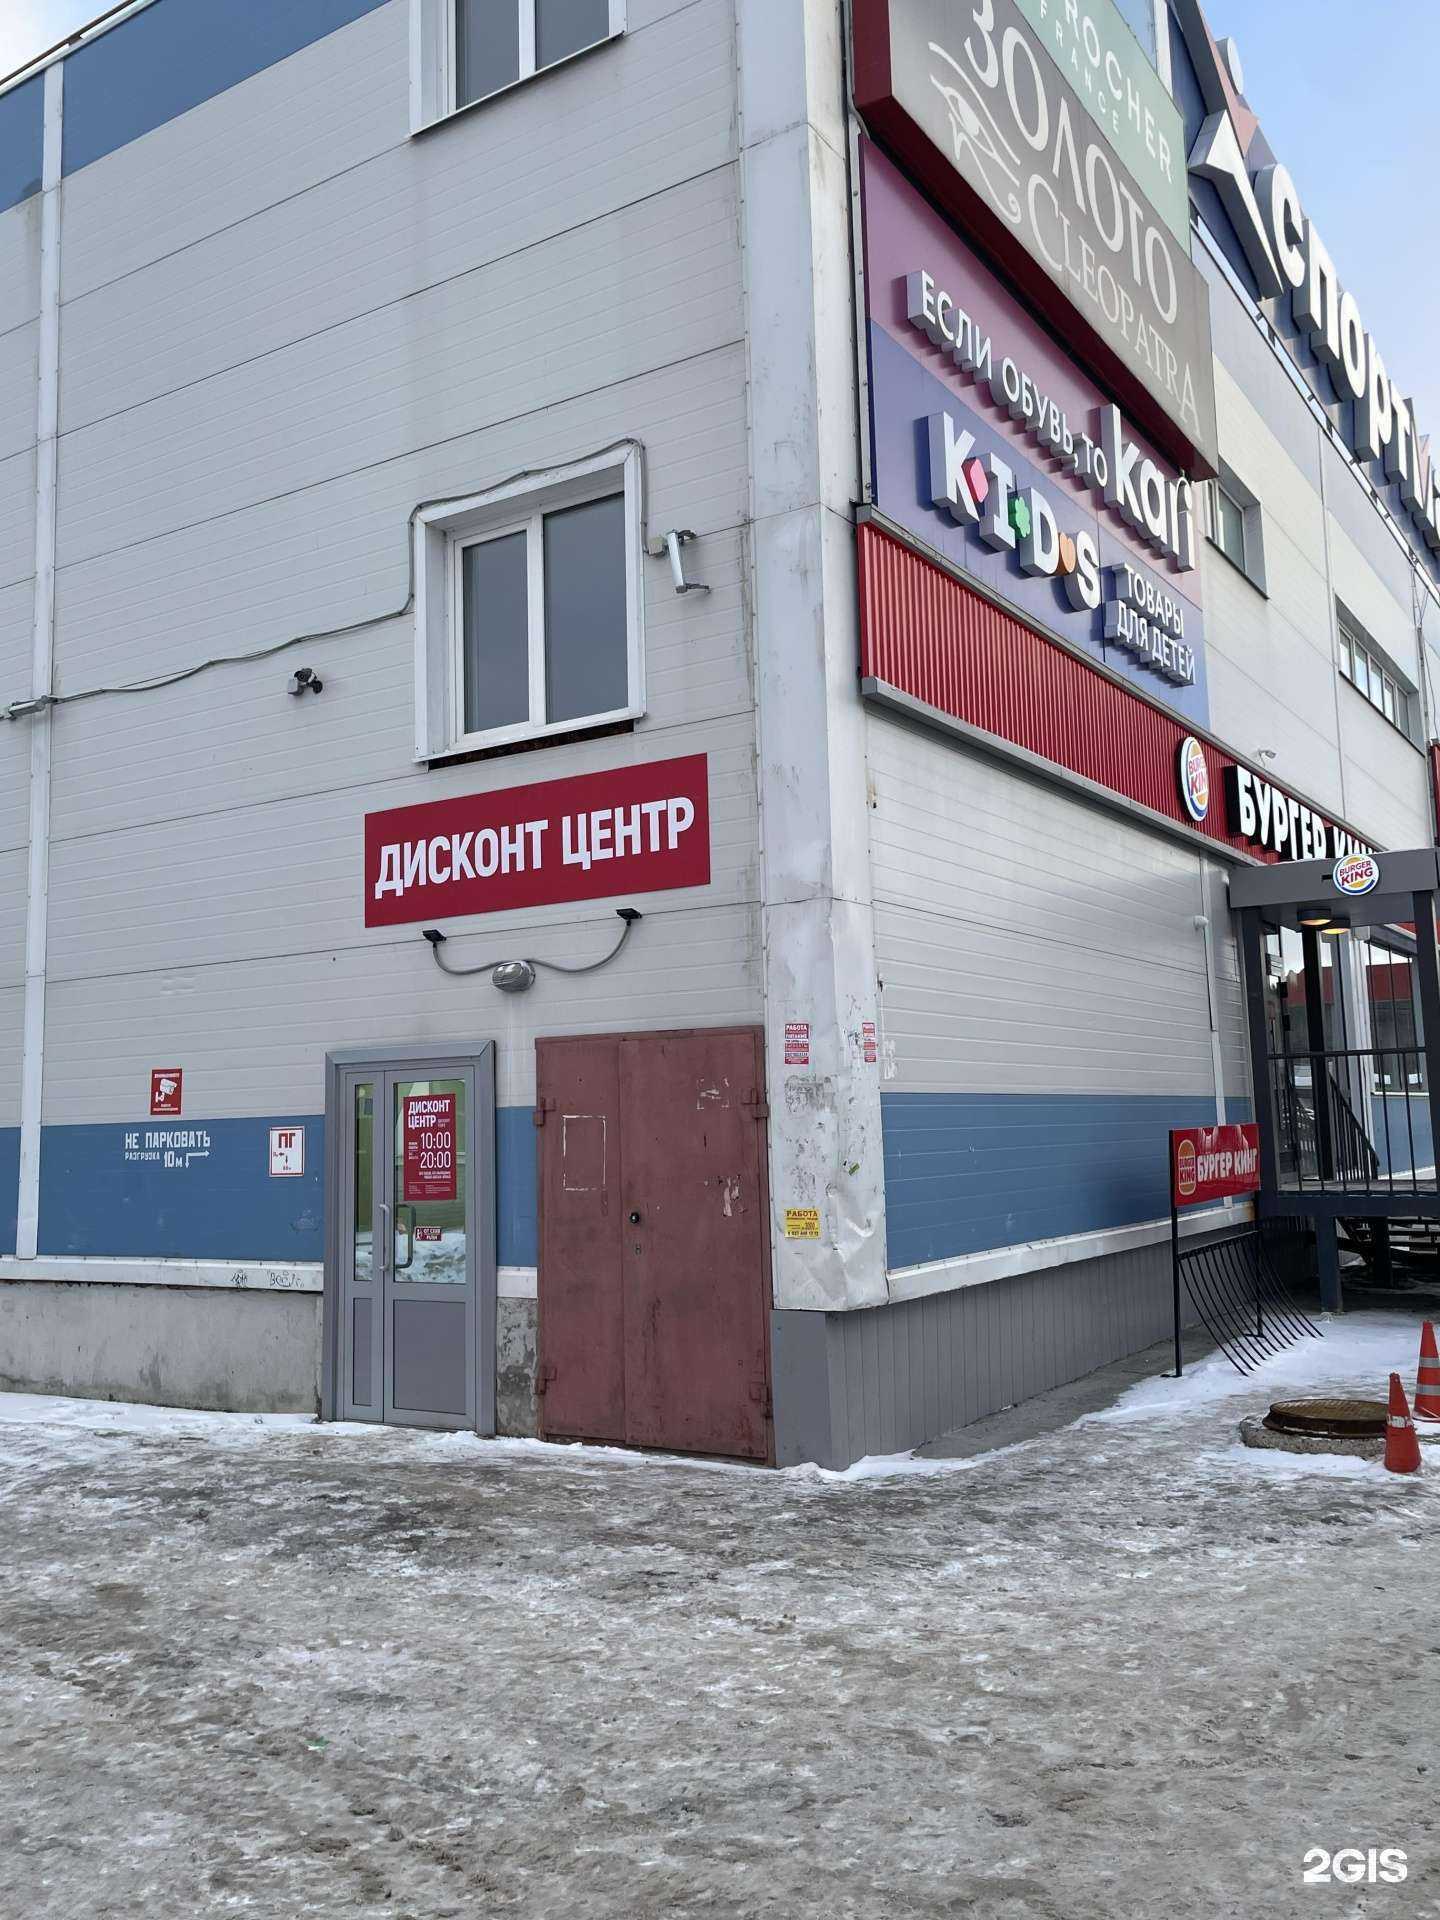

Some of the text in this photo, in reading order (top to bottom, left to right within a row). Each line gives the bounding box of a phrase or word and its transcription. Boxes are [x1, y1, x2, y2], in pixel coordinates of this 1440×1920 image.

[1041, 0, 1119, 134] FRANCE
[1065, 0, 1172, 184] ROCHER
[964, 0, 1177, 325] ЗОЛОТО
[921, 269, 993, 380] ЕСЛИ
[1027, 174, 1204, 443] CLEOPATRA
[942, 411, 1101, 609] KIDS
[1123, 561, 1185, 639] ТОВАРЫ
[1117, 599, 1196, 685] ДЛЯ ДЕТЕЙ
[374, 796, 696, 900] ДИСКОНТ ЦЕНТР
[1339, 860, 1372, 877] BURGER
[1341, 867, 1374, 887] KING
[408, 1099, 451, 1115] ДИСКОНТ
[408, 1114, 437, 1130] ЦЕНТР
[125, 1130, 211, 1149] НЕ ПАРКОВАТЬ
[278, 1132, 296, 1148] ПГ
[420, 1131, 451, 1149] 10:00
[420, 1151, 451, 1169] 20:00
[1197, 1147, 1258, 1183] БУРГЕР КИНГ
